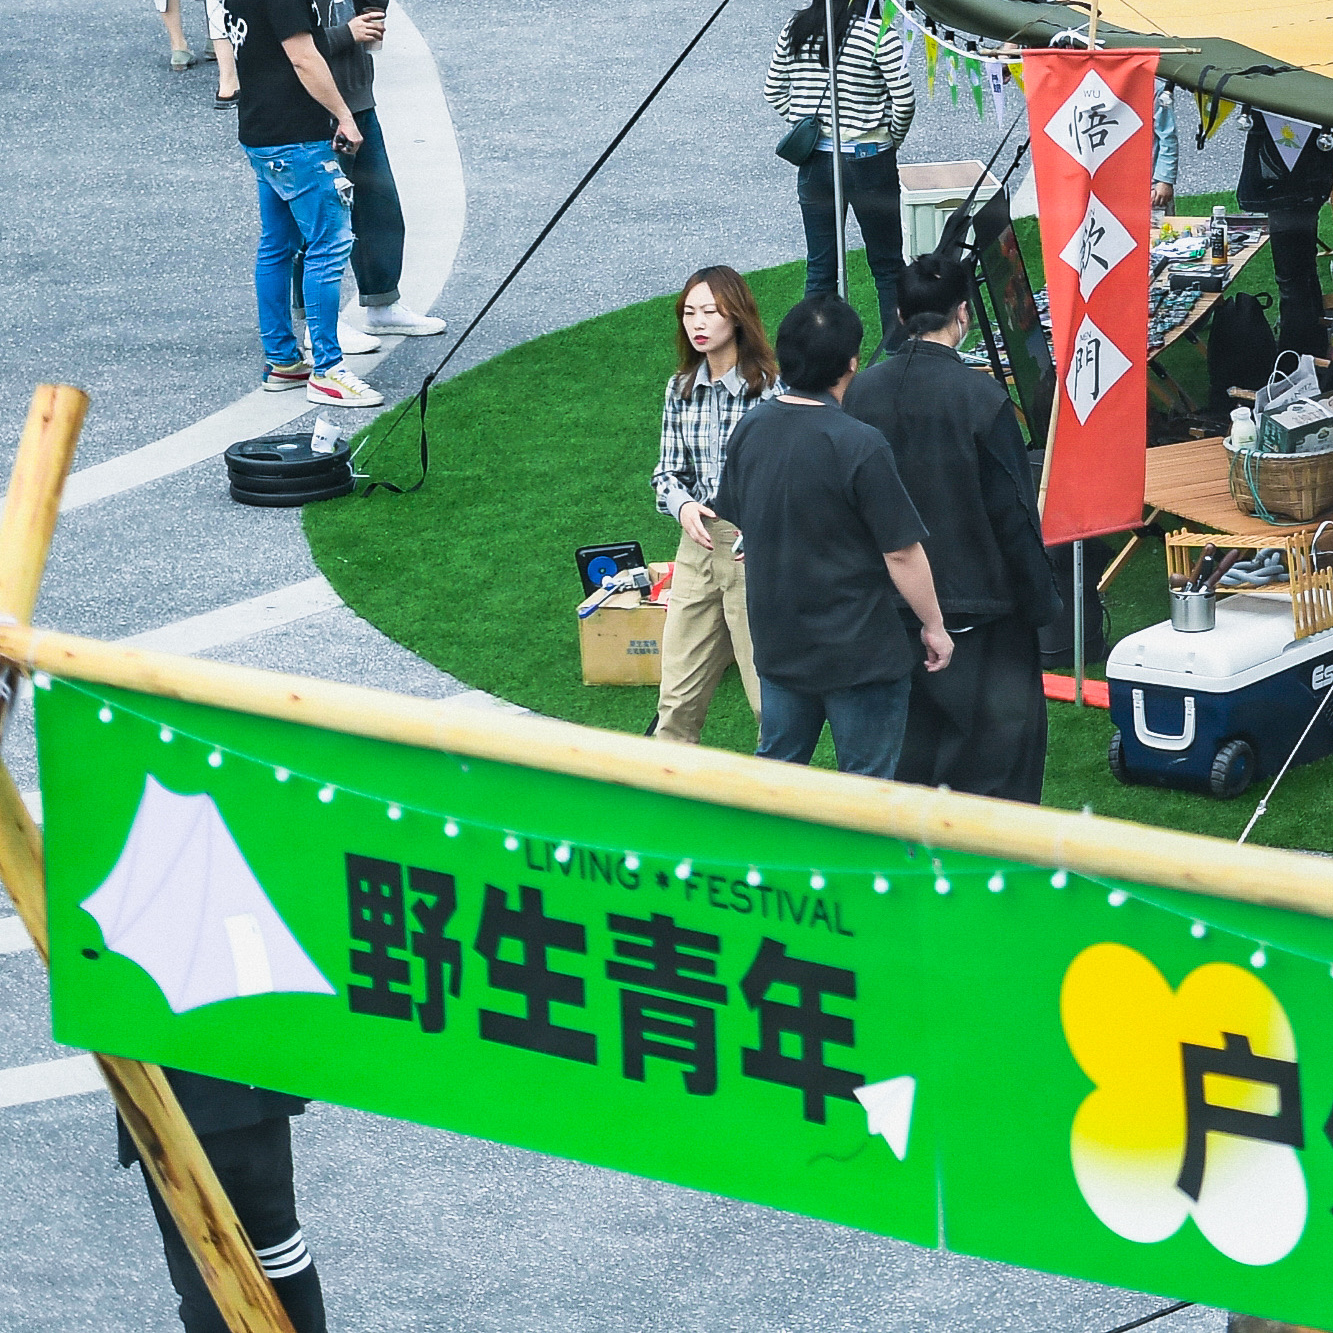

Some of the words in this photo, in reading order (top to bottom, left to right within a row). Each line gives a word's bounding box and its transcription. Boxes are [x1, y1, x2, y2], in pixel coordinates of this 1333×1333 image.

[1082, 89, 1102, 99] WU
[526, 836, 642, 891] LIVING
[684, 870, 855, 937] FESTIVAL
[344, 850, 868, 1126] 野生青年
